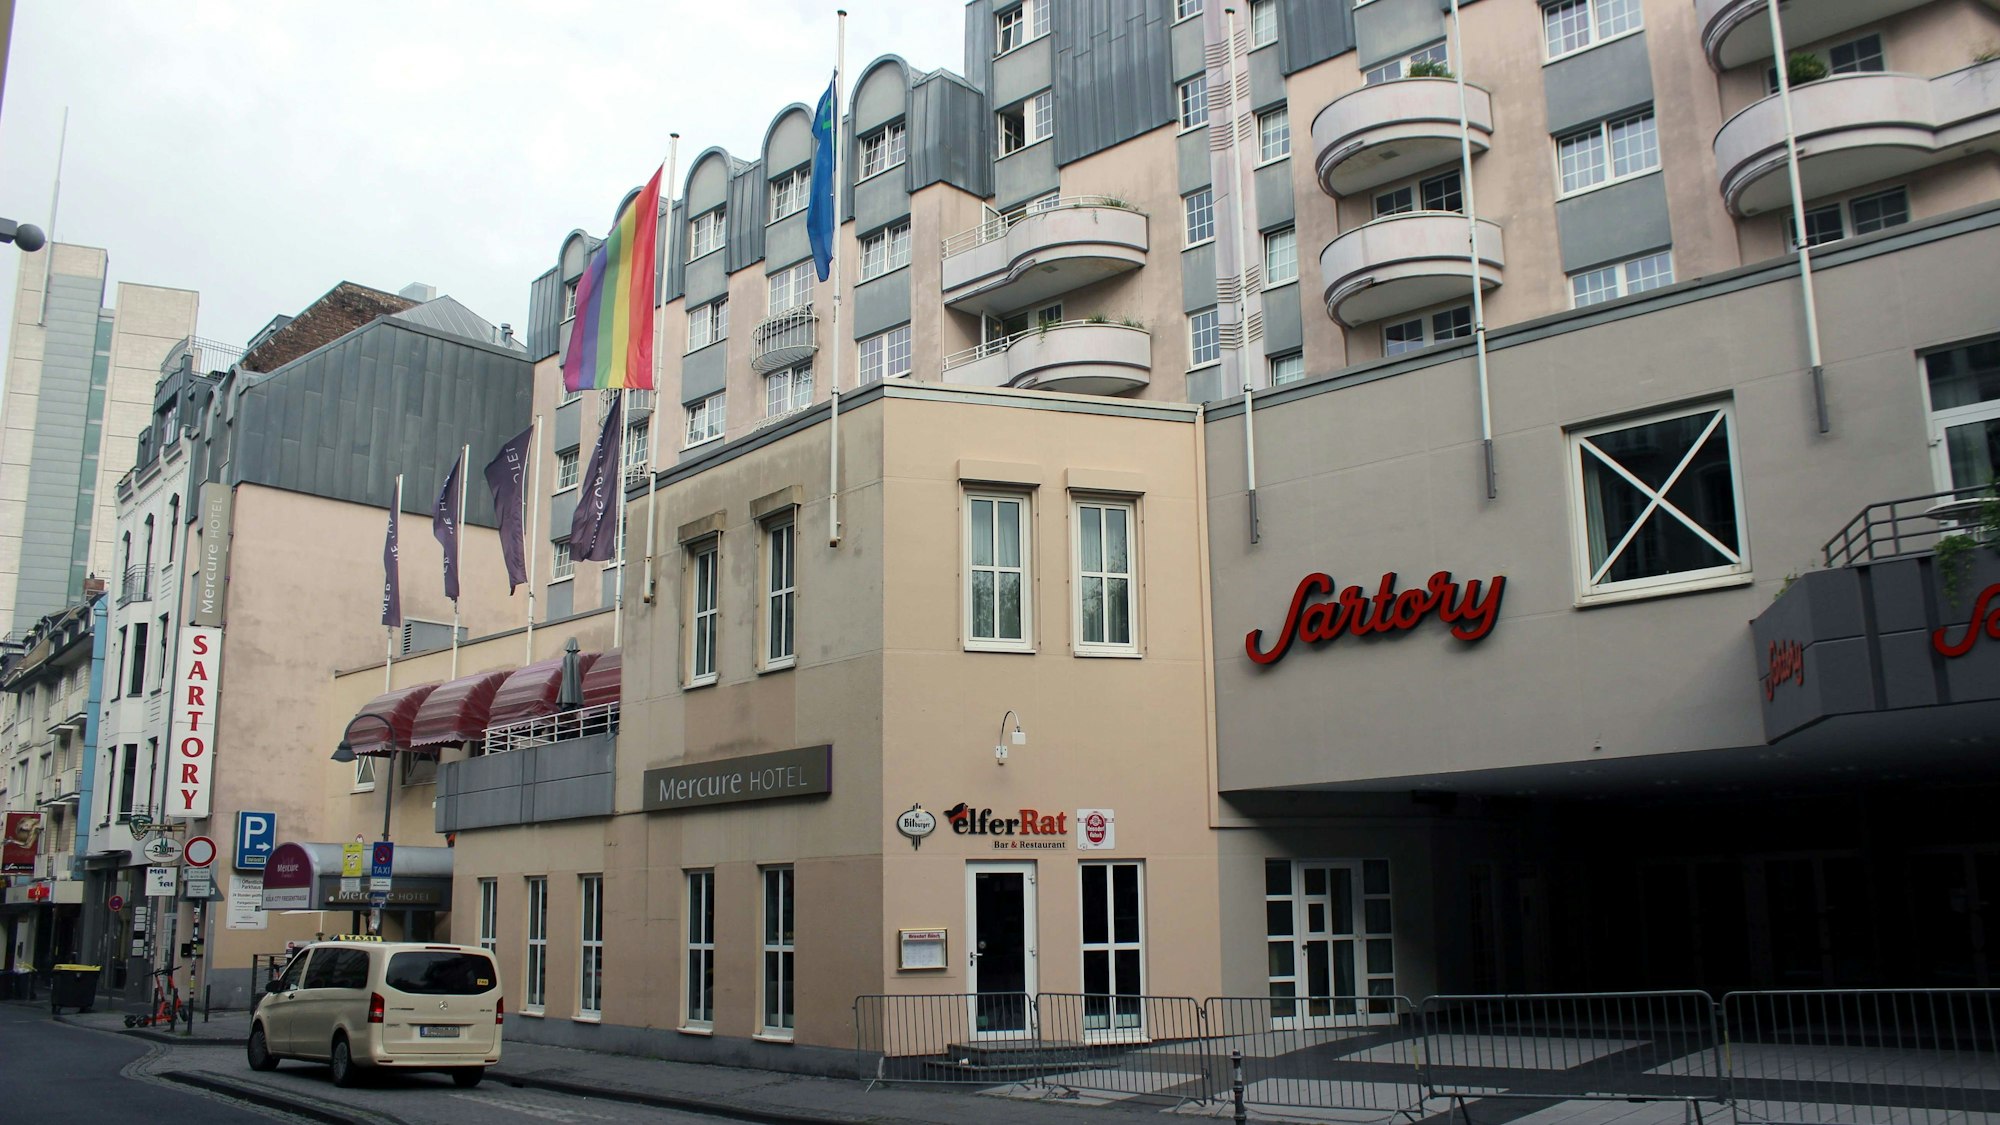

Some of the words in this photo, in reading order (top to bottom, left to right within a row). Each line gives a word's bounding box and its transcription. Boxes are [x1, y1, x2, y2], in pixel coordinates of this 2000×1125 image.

[201, 544, 219, 614] Mercure
[210, 497, 223, 539] HOTEL
[1245, 571, 1506, 665] Sartory
[180, 634, 208, 810] SARTORY
[659, 772, 742, 802] Mercure
[750, 766, 808, 792] HOTEL
[245, 816, 267, 849] P
[904, 818, 931, 829] Bitburger
[952, 808, 1068, 835] elferRat
[994, 841, 1009, 849] Bar
[1010, 841, 1018, 849] &
[1019, 841, 1066, 849] Restaurant
[277, 864, 299, 873] Mercure
[374, 866, 390, 875] TAXI
